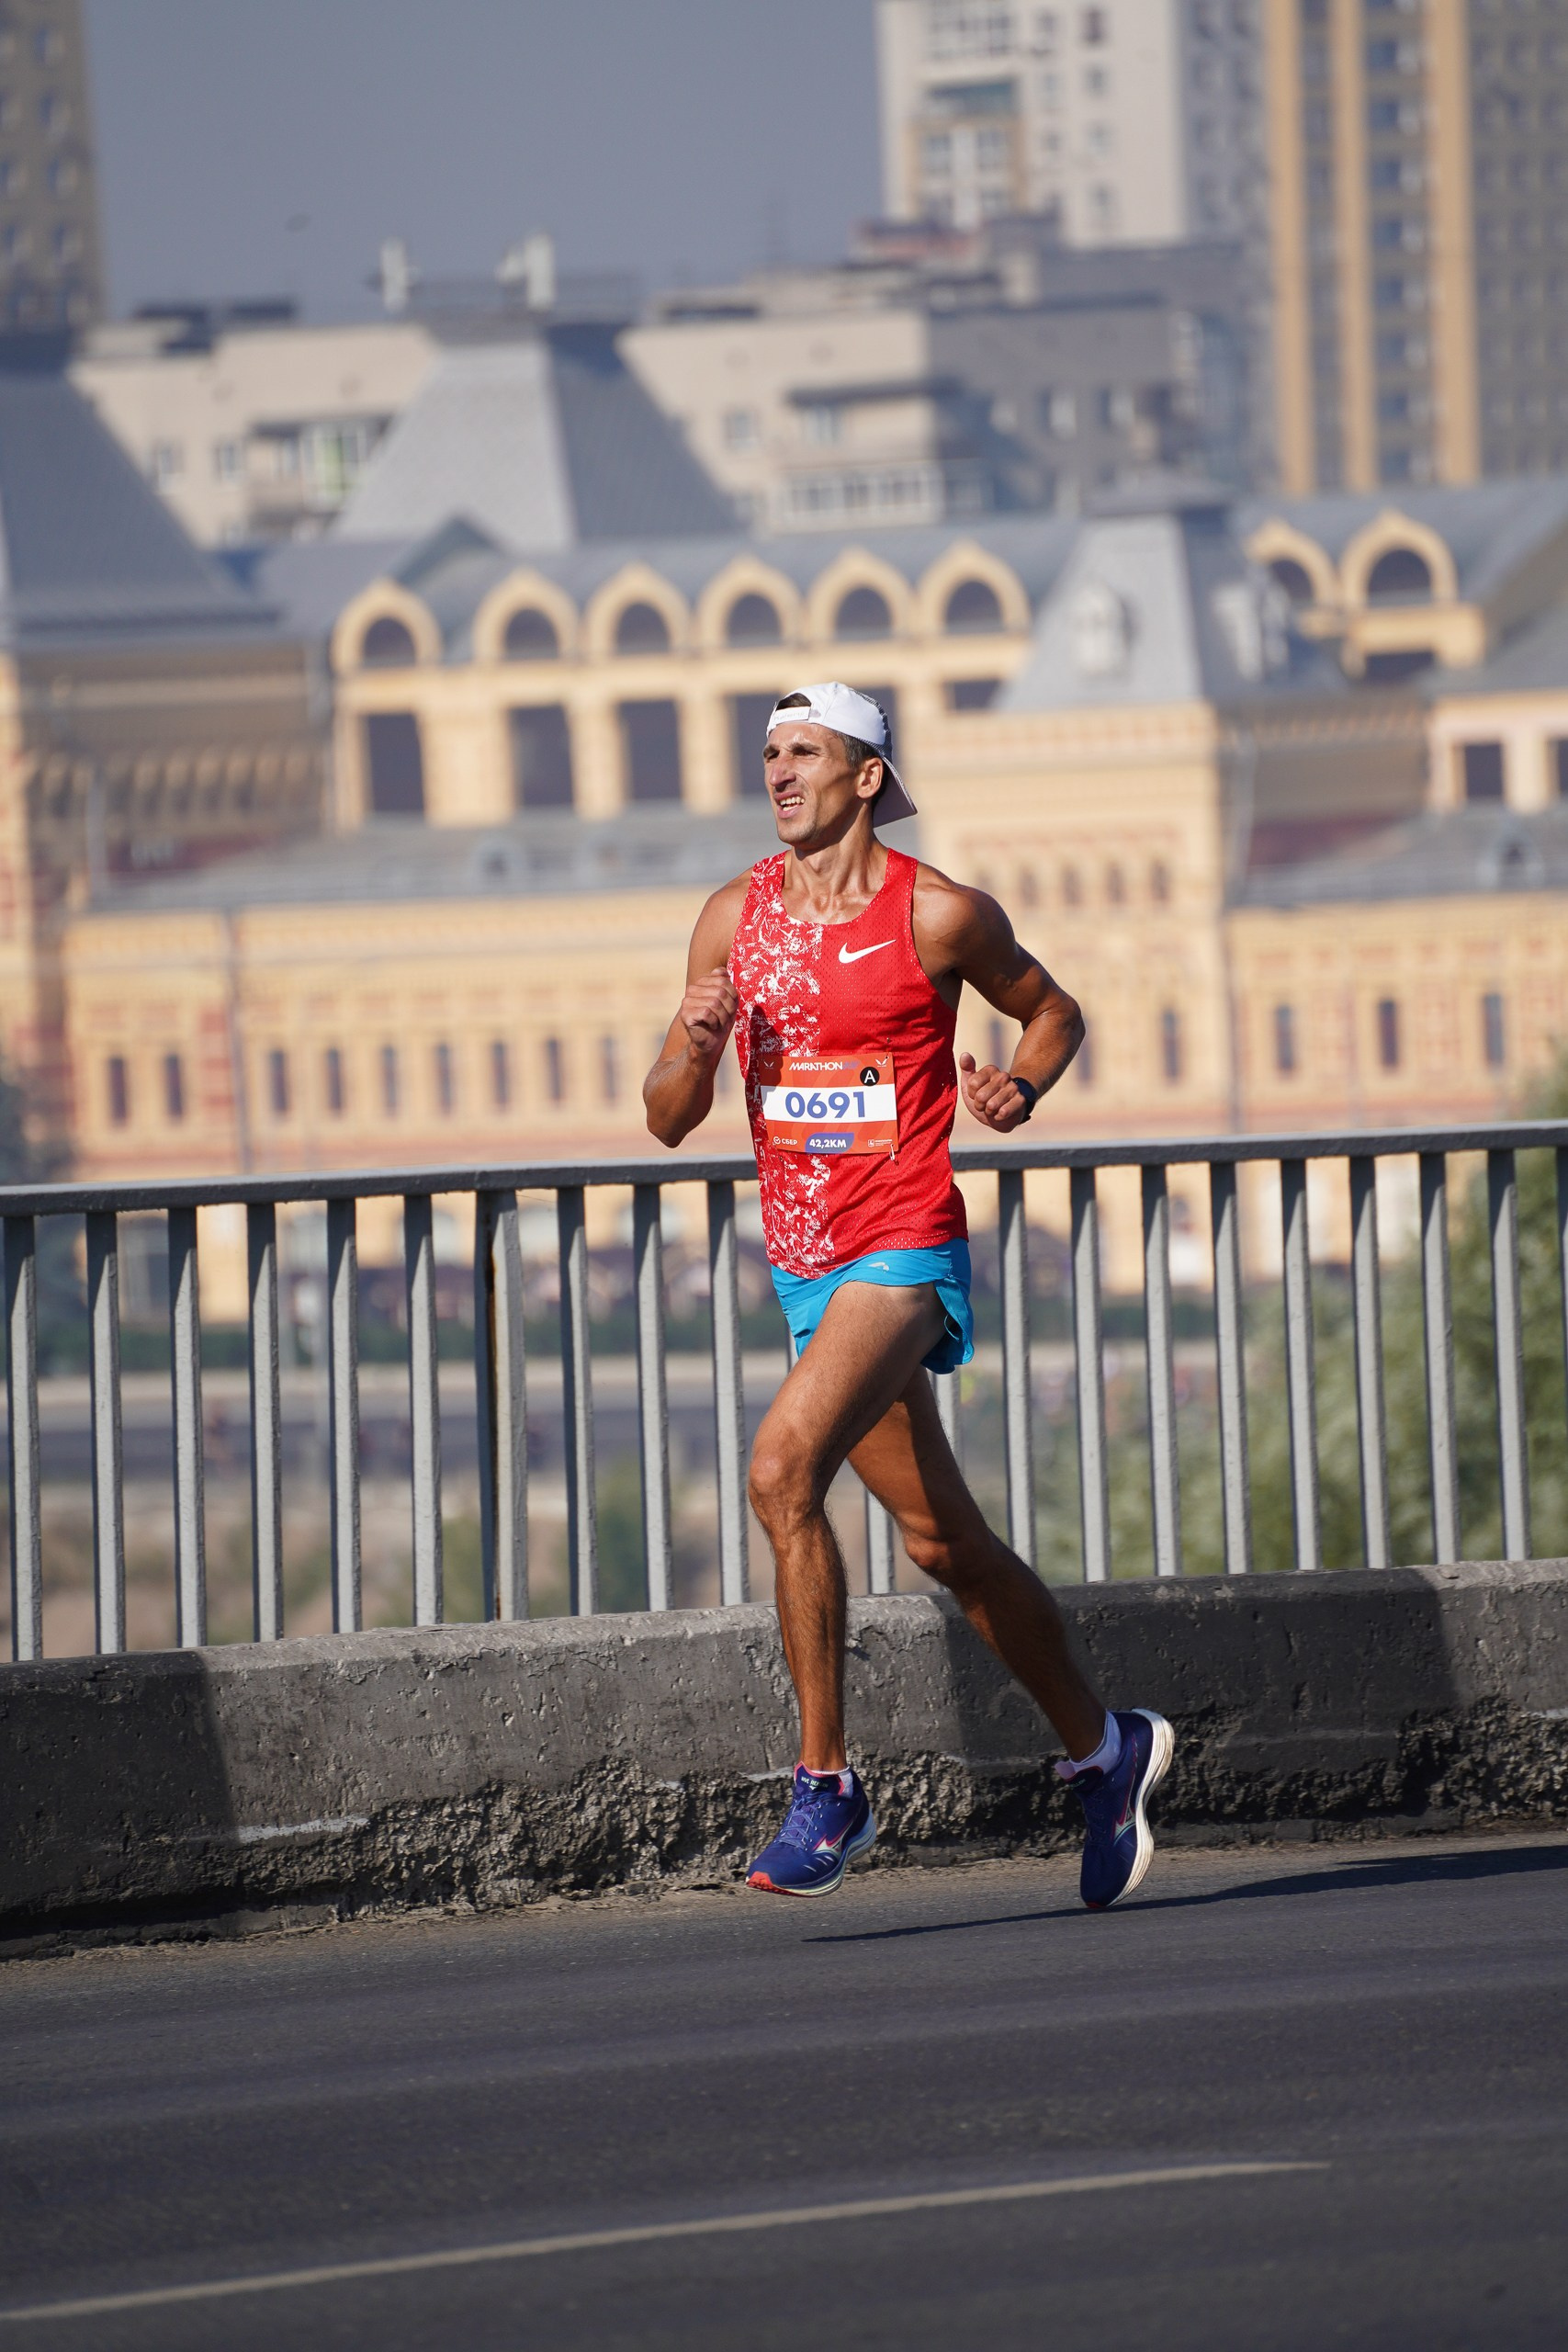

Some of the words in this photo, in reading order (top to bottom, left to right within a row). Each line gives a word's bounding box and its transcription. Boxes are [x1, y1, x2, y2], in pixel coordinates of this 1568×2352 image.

[789, 1061, 843, 1071] MARATHON
[863, 1069, 876, 1084] A
[784, 1091, 865, 1119] 0691
